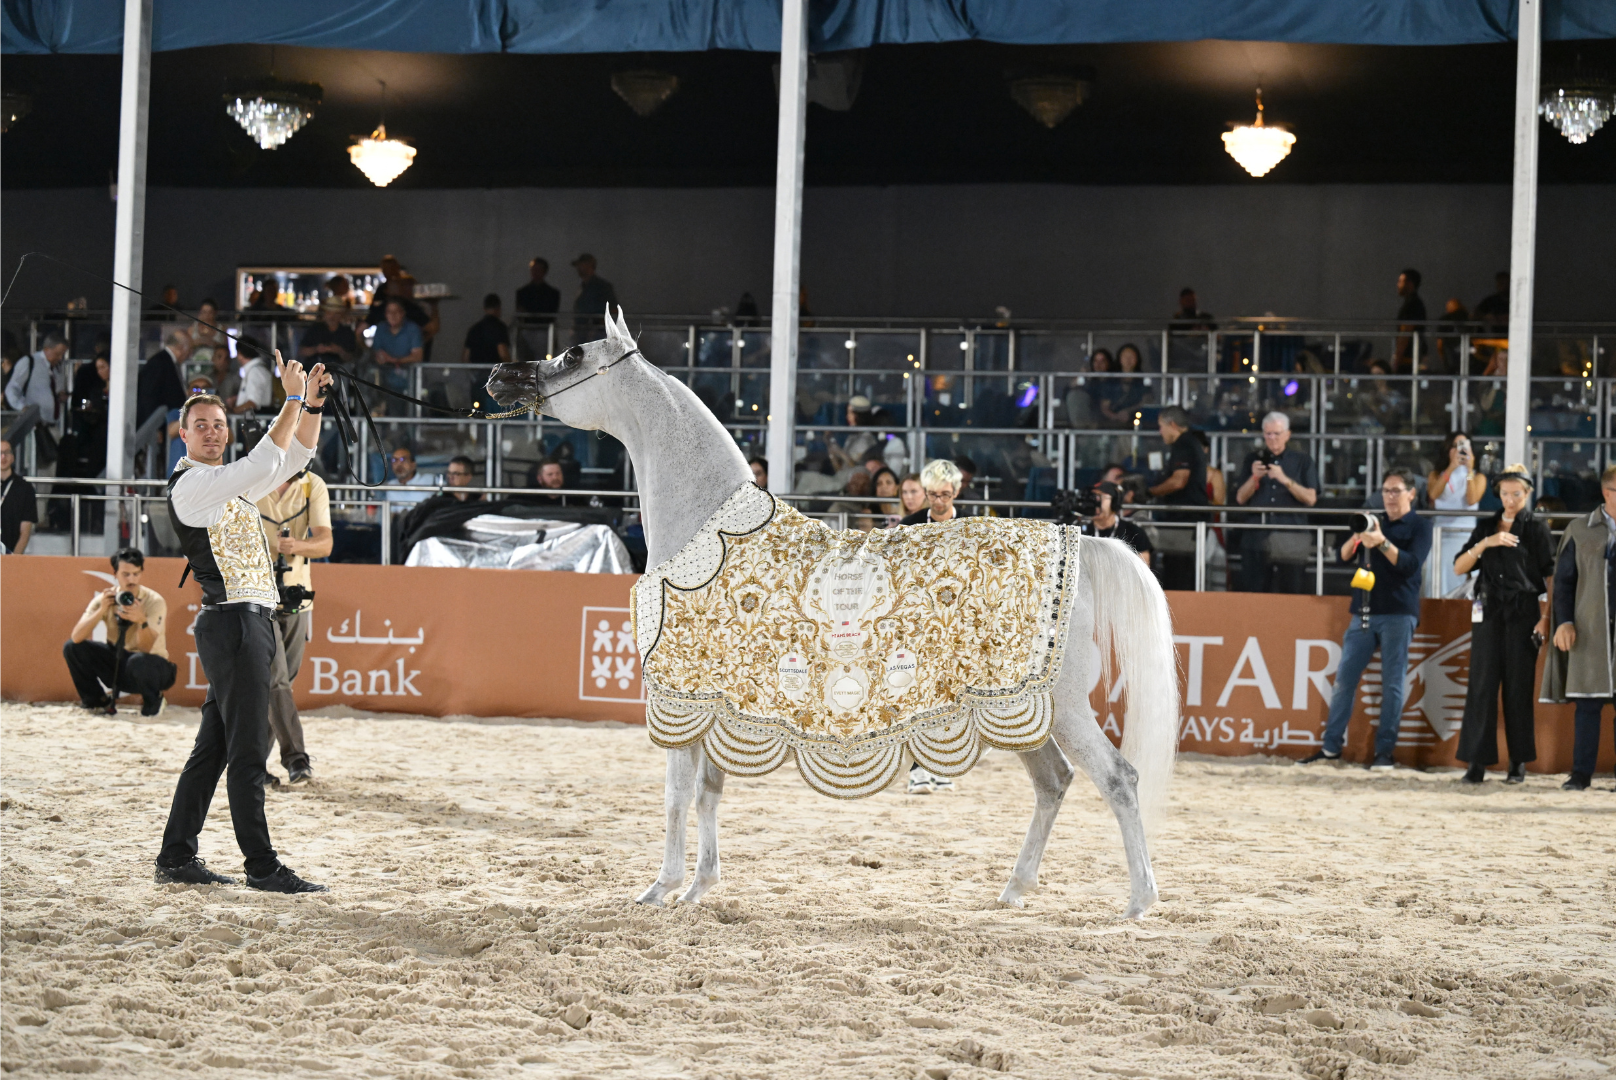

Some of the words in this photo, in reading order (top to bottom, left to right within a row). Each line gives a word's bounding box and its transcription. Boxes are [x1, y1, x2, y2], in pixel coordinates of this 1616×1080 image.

[845, 587, 863, 595] THE
[327, 610, 424, 654] بنك
[309, 657, 422, 696] Bank
